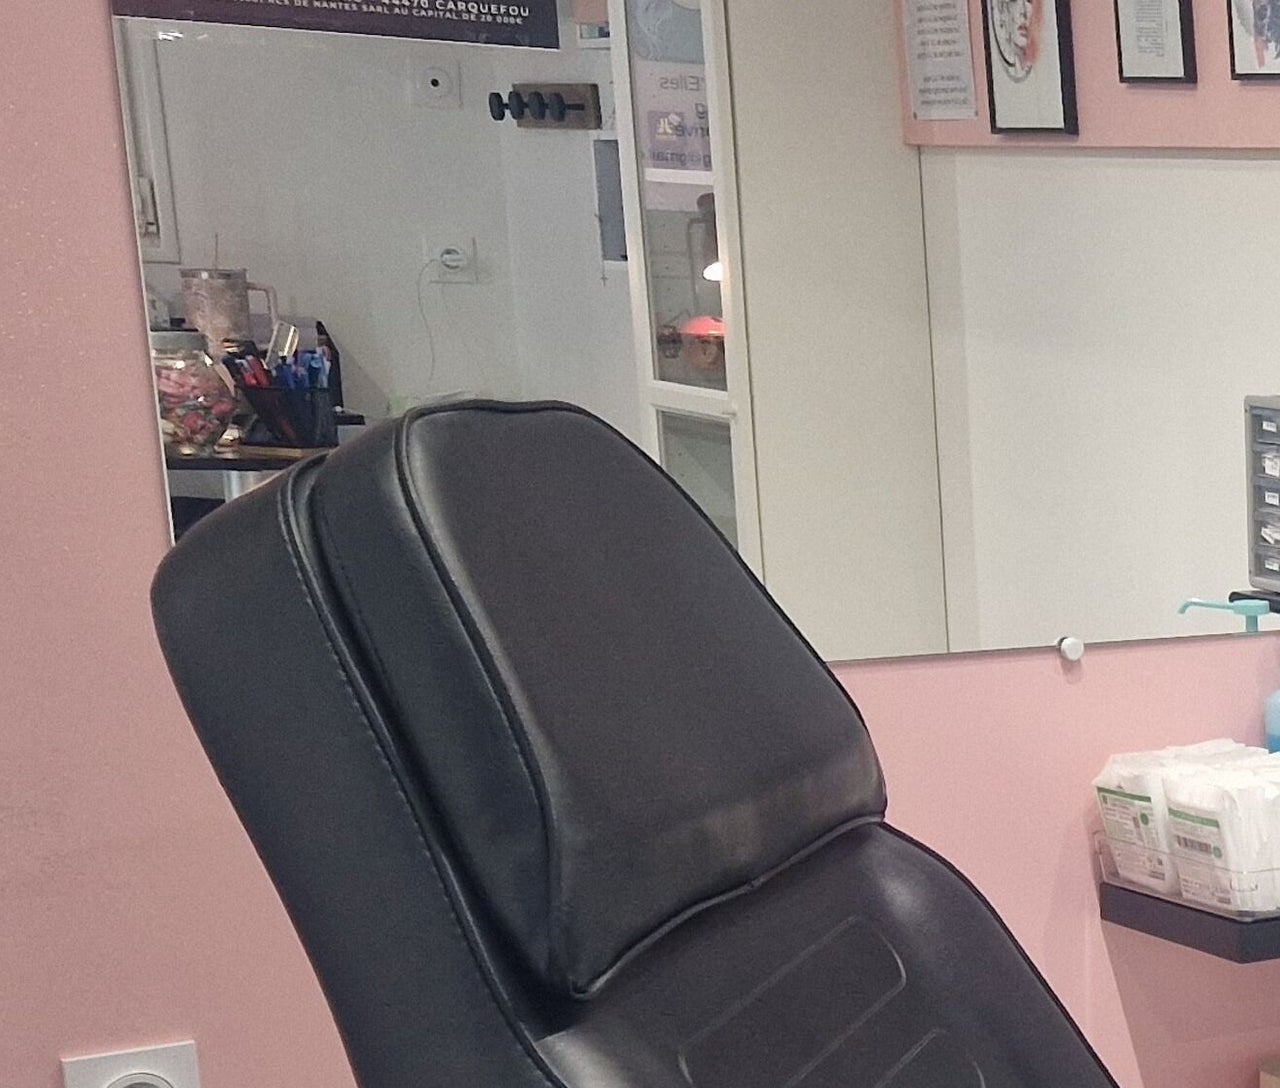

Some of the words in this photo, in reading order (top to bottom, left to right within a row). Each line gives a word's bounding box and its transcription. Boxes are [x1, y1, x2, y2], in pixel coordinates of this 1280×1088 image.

[314, 1, 358, 11] NANTES
[362, 4, 389, 14] SARL
[413, 9, 458, 20] CAPITAL
[436, 0, 530, 16] CARQUEFOU
